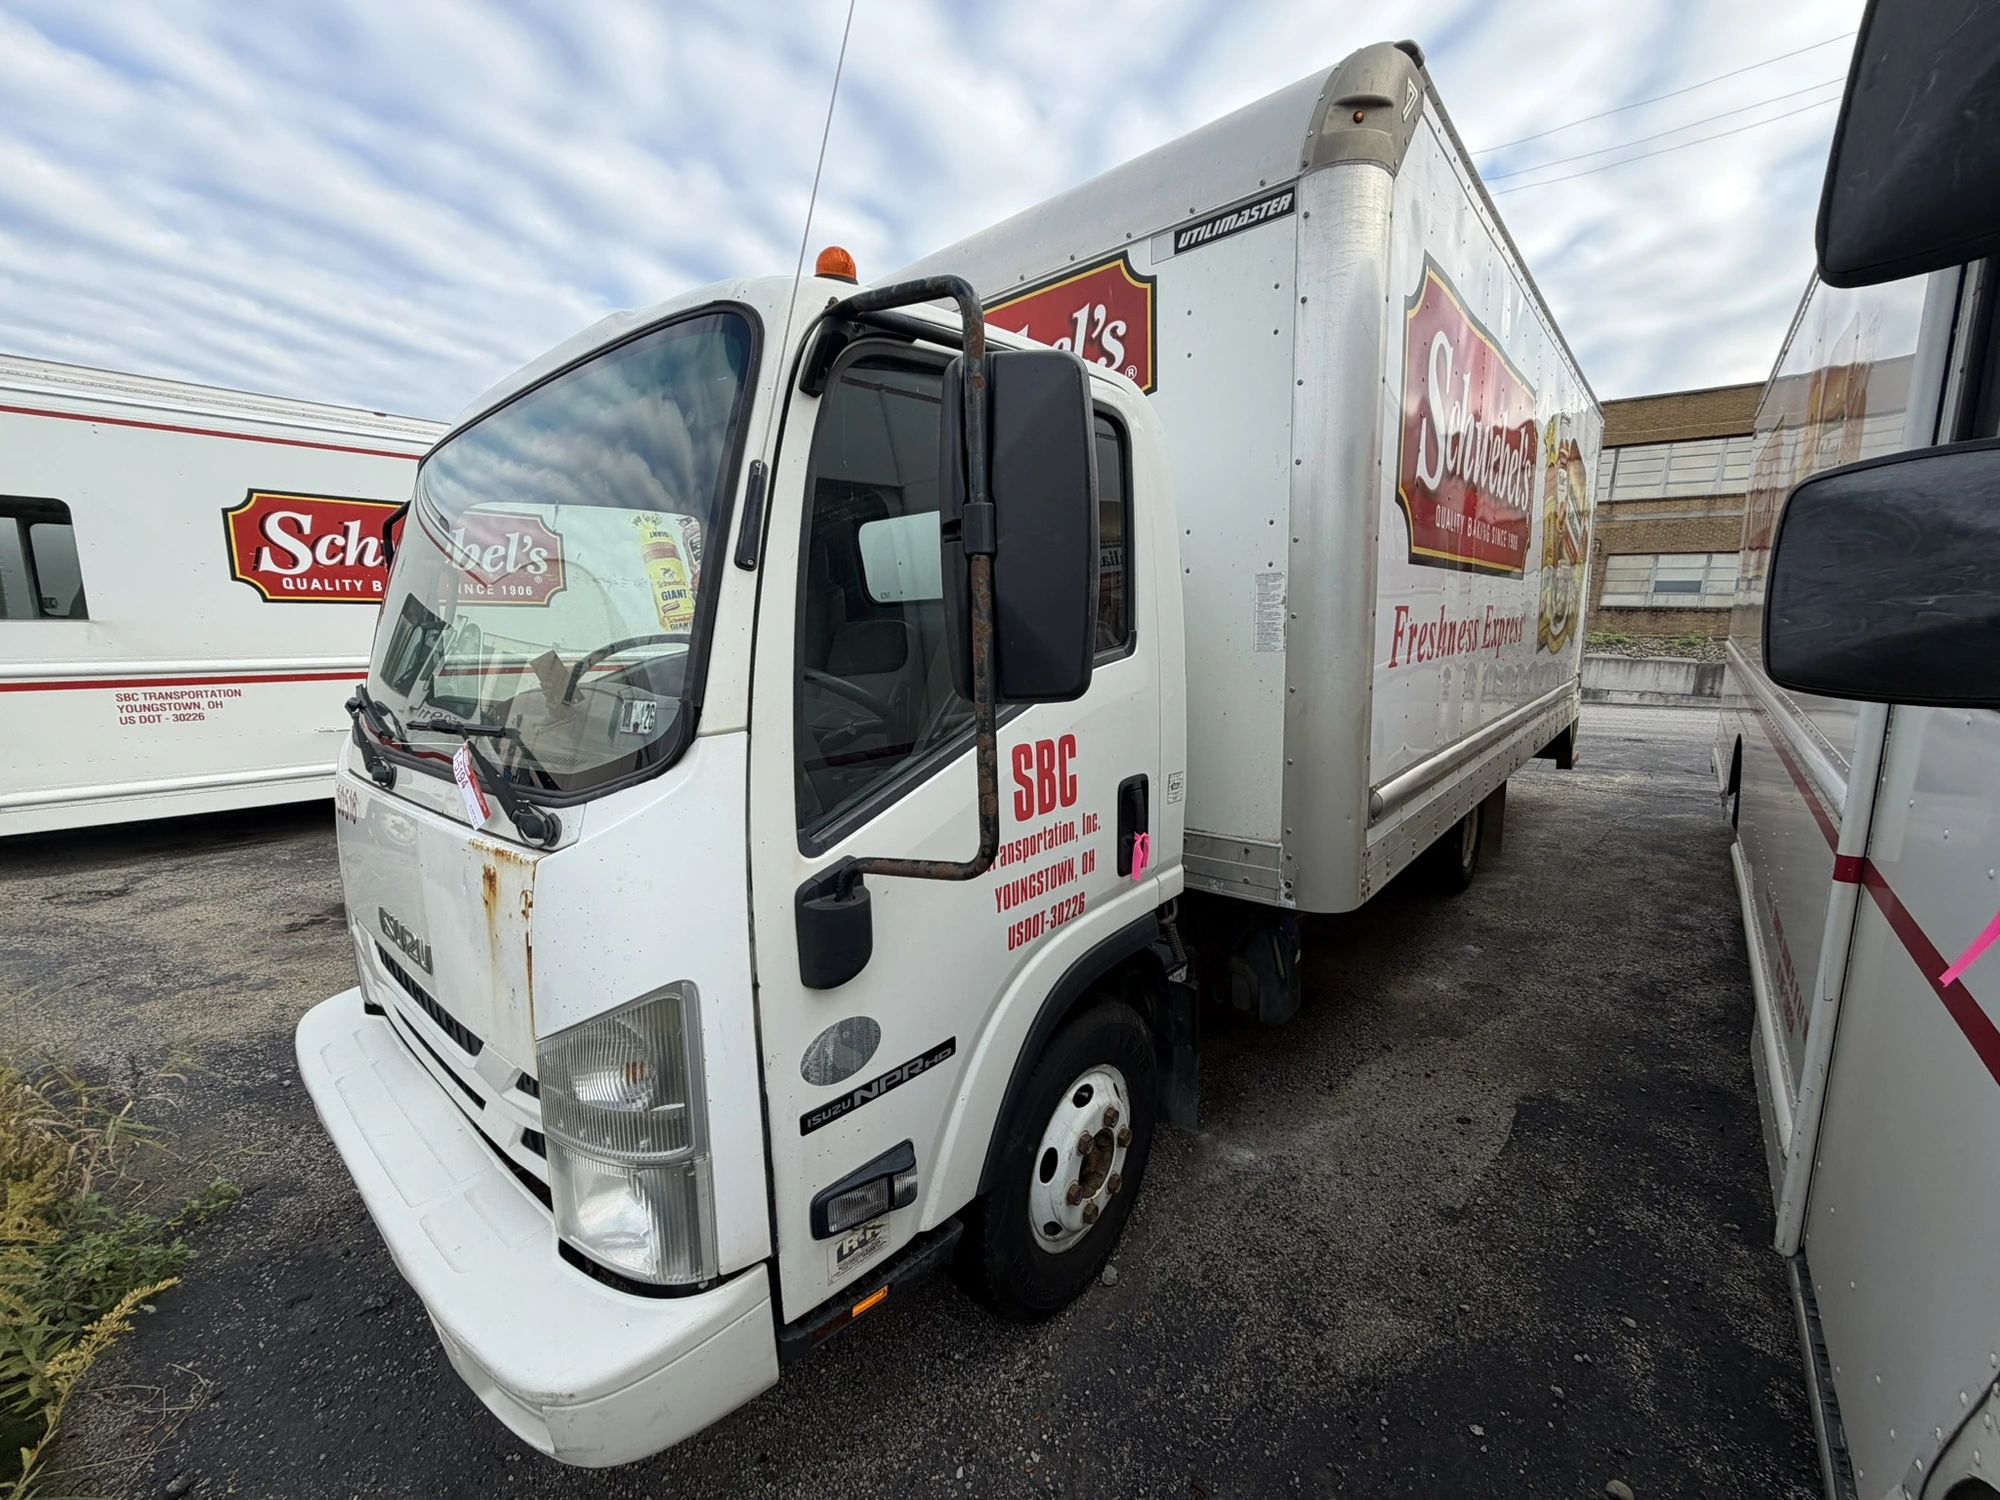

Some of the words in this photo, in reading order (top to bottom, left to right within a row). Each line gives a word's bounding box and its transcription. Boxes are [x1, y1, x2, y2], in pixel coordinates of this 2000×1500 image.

[1415, 330, 1531, 511] Schwebel's
[1435, 504, 1465, 535] QUALITY
[1467, 517, 1490, 543] BAKING
[1492, 526, 1507, 547] SINCE
[282, 577, 363, 591] QUALITY
[458, 584, 495, 595] INCE
[501, 585, 533, 596] 1906
[661, 589, 687, 602] GIANT
[1388, 604, 1480, 668] Freshness
[1481, 605, 1523, 658] Express
[115, 692, 140, 702] SBC
[141, 688, 242, 701] TRANSPORTATION
[117, 701, 205, 713] YOUNGSTOWN,
[207, 700, 223, 709] OH
[119, 715, 136, 725] US
[138, 714, 163, 724] DOT
[172, 712, 205, 722] 30226
[454, 752, 469, 790] 1-5194
[1011, 733, 1077, 822] SBC
[987, 821, 1078, 872] ransportation,
[1082, 812, 1101, 836] Inc.
[994, 857, 1078, 914] YOUNGSTOWN,
[1082, 848, 1095, 876] OH
[1008, 891, 1085, 951] USDOT-30226
[807, 1098, 850, 1128] ISUZU
[853, 1057, 924, 1107] NPR
[924, 1047, 952, 1068] HD
